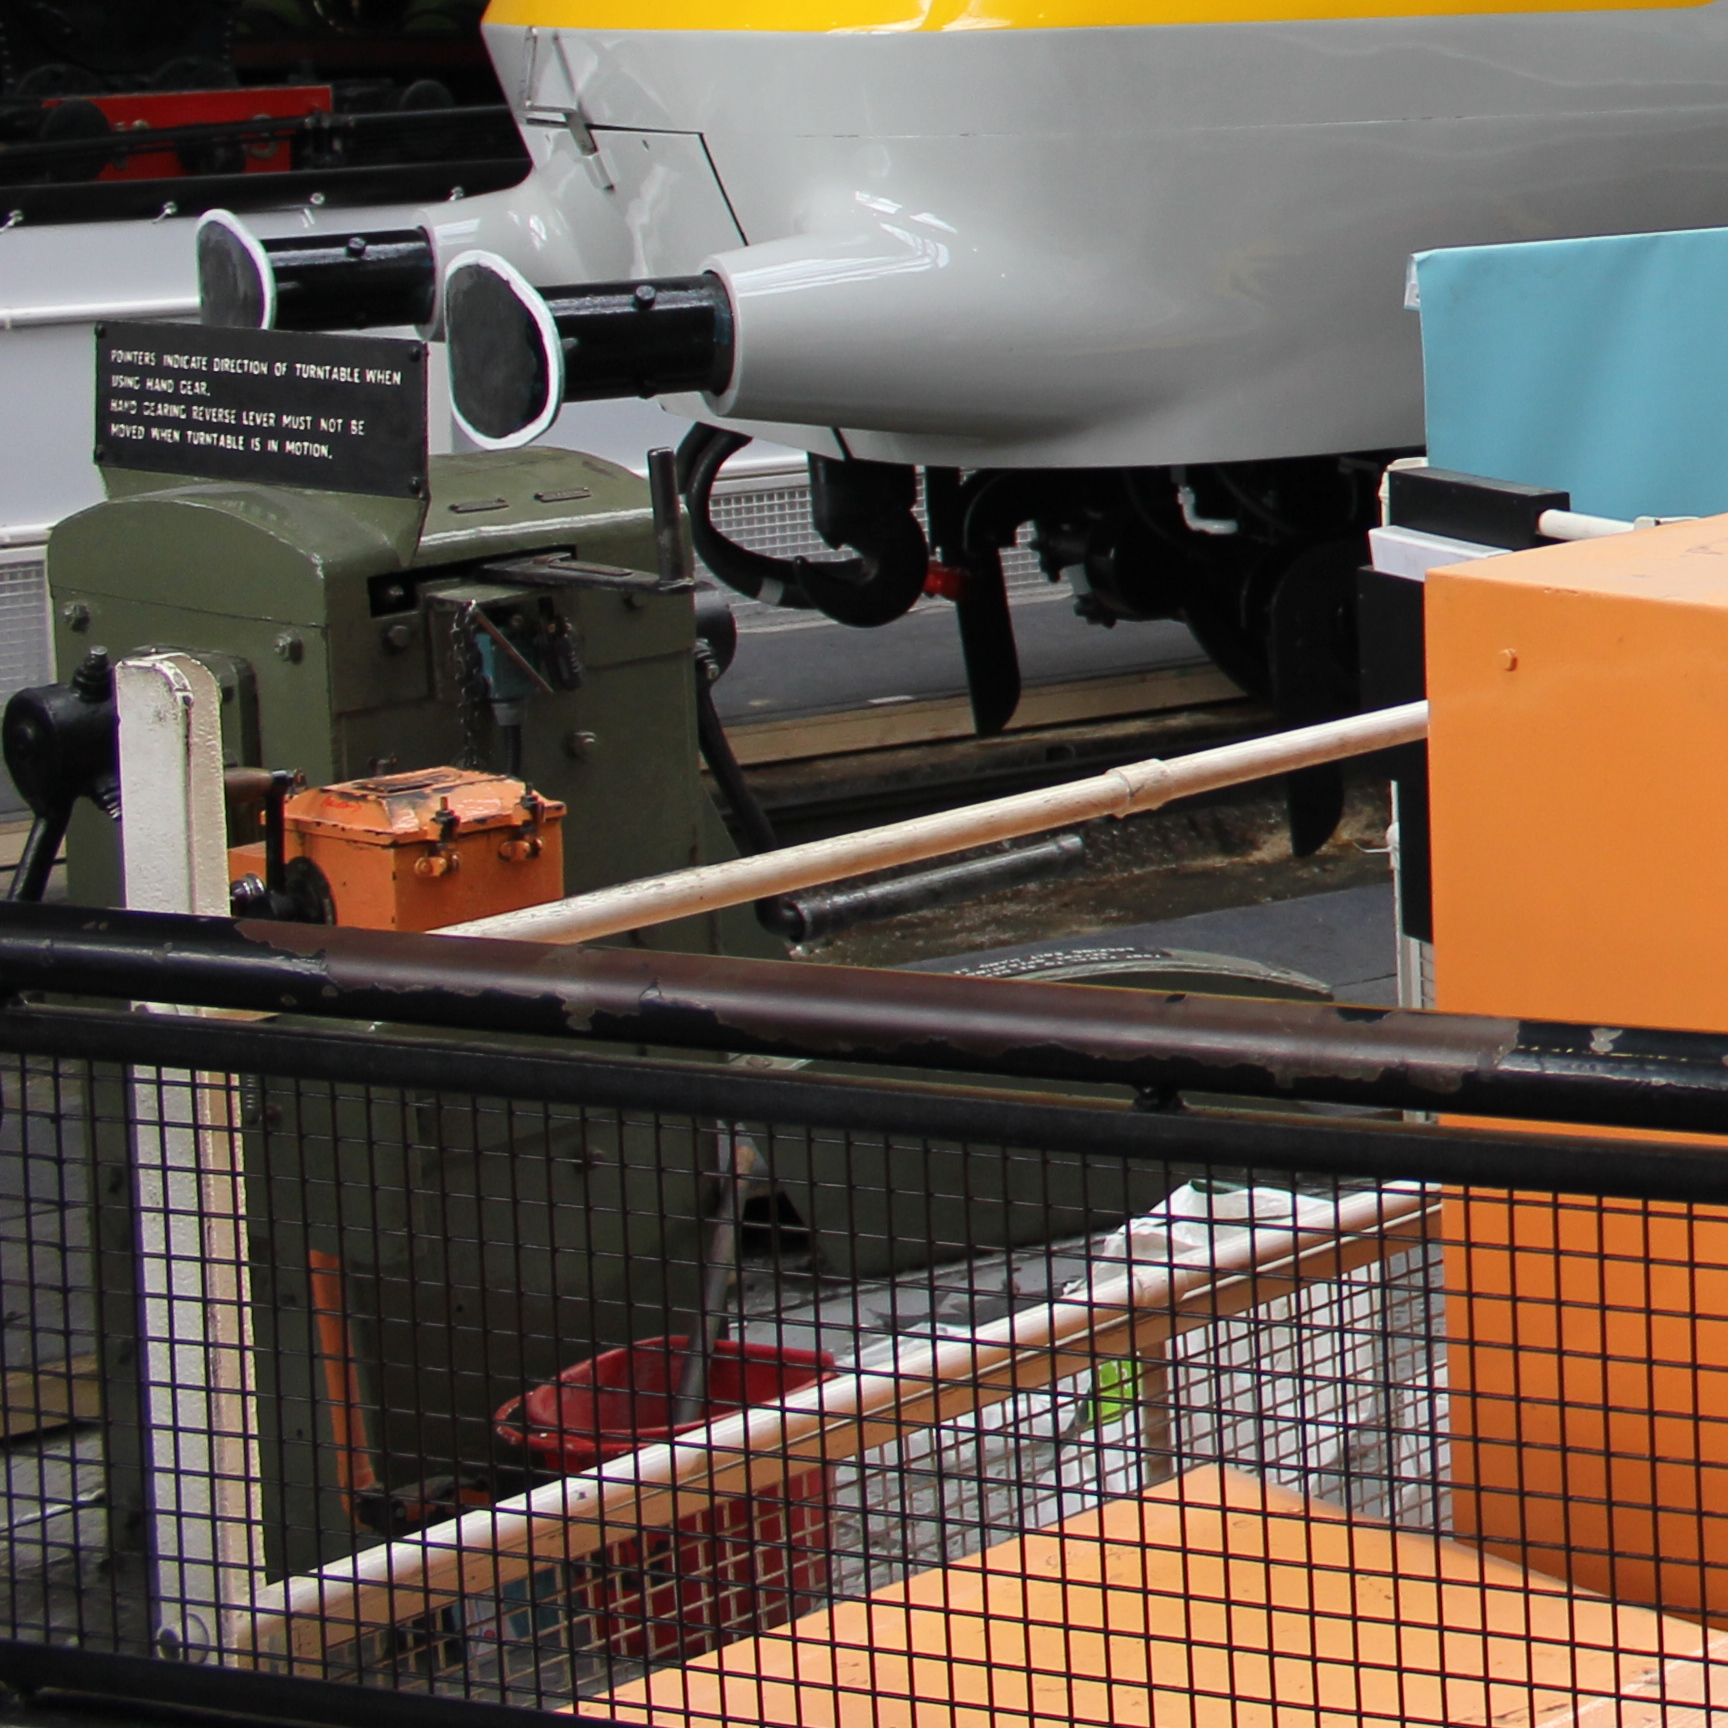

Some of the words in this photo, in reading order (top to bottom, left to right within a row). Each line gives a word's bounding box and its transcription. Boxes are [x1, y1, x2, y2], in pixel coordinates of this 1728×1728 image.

[110, 349, 157, 367] POINTERS
[163, 354, 209, 371] INDICATE
[213, 357, 268, 375] DIRECTION
[274, 361, 288, 377] OF
[295, 363, 361, 384] TURNTABLE
[365, 369, 402, 385] WHEN
[111, 374, 141, 390] USING
[145, 377, 175, 393] HAND
[110, 398, 138, 415] HAND
[191, 405, 237, 424] REVERSE
[242, 411, 276, 427] LEVER
[282, 414, 313, 430] MUST
[319, 418, 344, 433] NOT
[350, 419, 366, 436] BE
[110, 423, 146, 440] MOVED
[150, 427, 181, 443] WHEN
[186, 430, 245, 451] TURNTABLE
[250, 437, 262, 452] IS
[267, 439, 279, 453] IN
[284, 440, 333, 460] MOTION.
